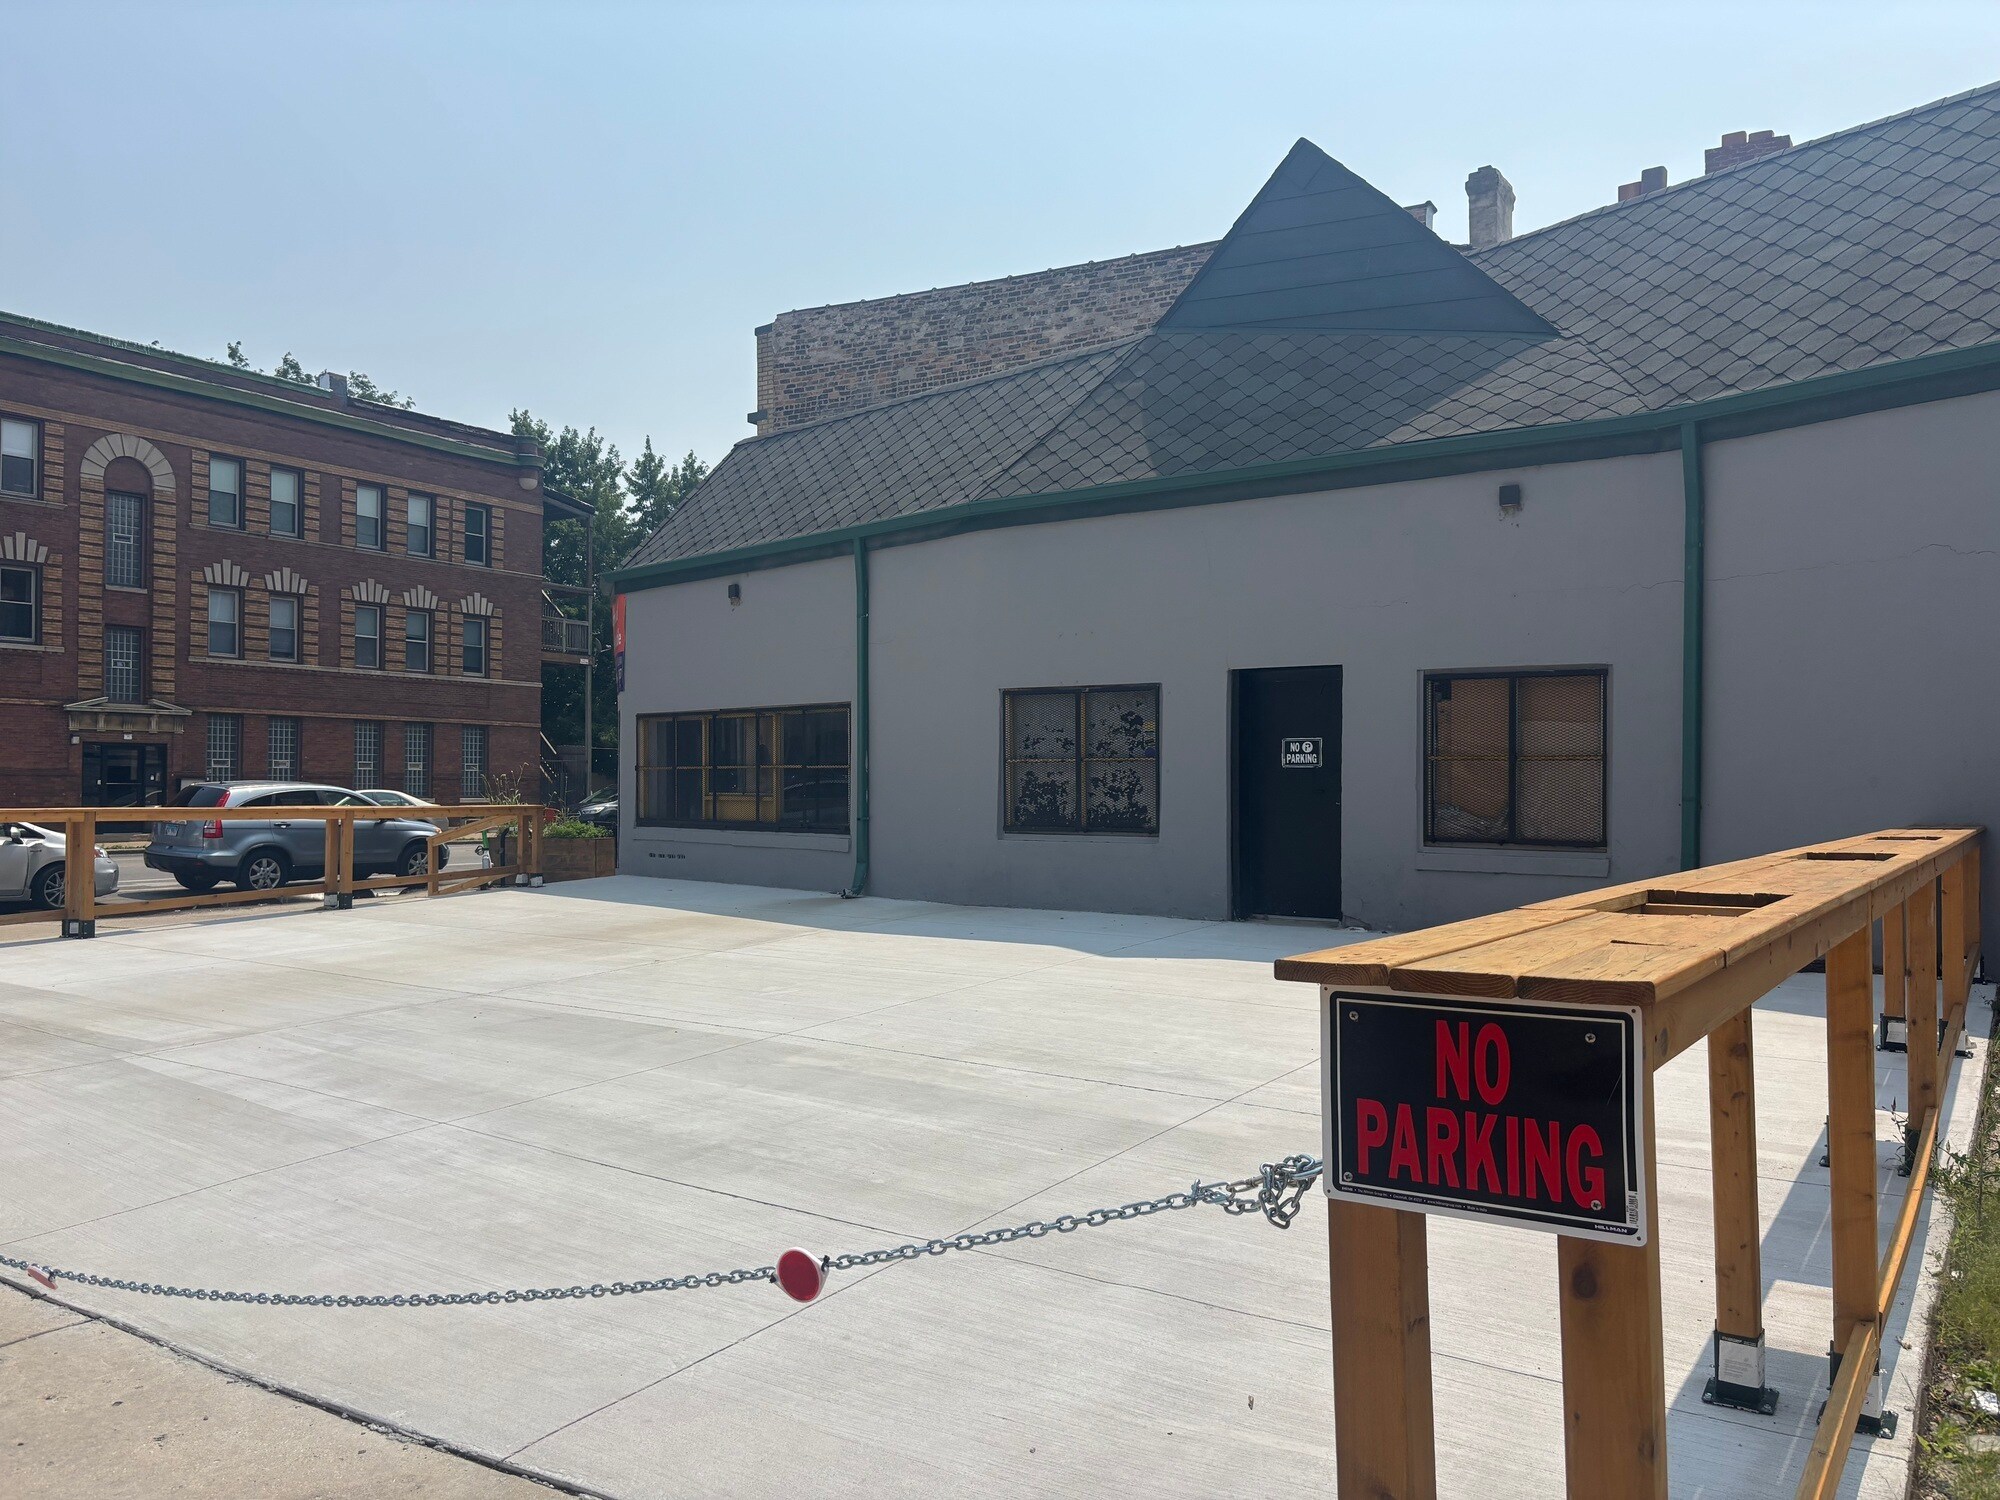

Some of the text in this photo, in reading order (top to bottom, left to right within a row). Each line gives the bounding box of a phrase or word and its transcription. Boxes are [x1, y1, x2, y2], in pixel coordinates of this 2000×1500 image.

[1290, 742, 1300, 752] NO
[1286, 753, 1317, 764] PARKING
[1436, 1020, 1511, 1106] NO
[1356, 1098, 1606, 1210] PARKING
[1594, 1224, 1628, 1233] HILLMAN
